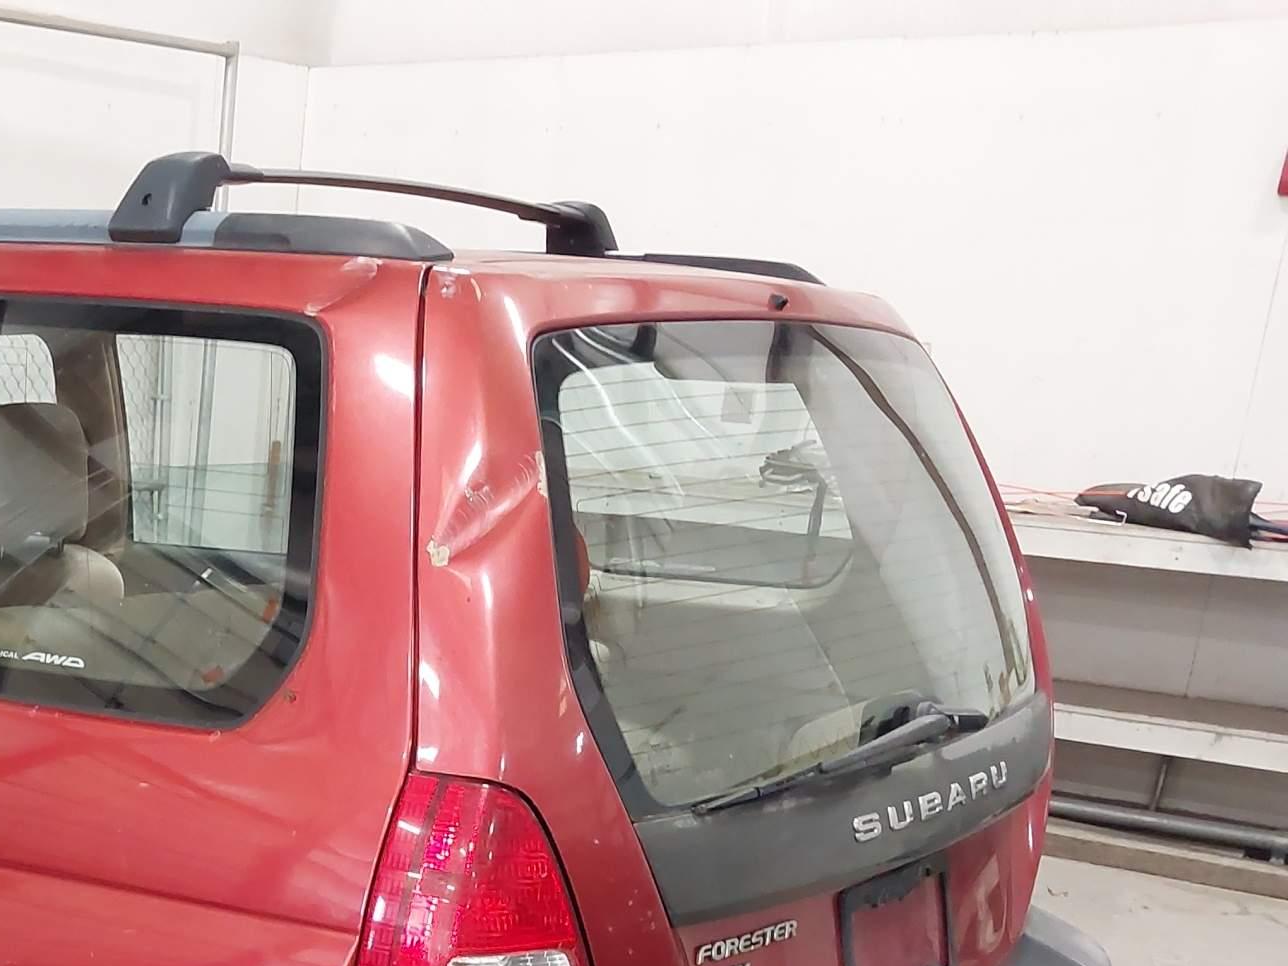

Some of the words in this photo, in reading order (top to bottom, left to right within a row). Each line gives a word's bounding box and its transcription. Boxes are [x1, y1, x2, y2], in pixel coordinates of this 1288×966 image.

[22, 651, 85, 669] AWD
[852, 760, 1009, 843] SUBARU
[696, 919, 798, 966] FORESTER
